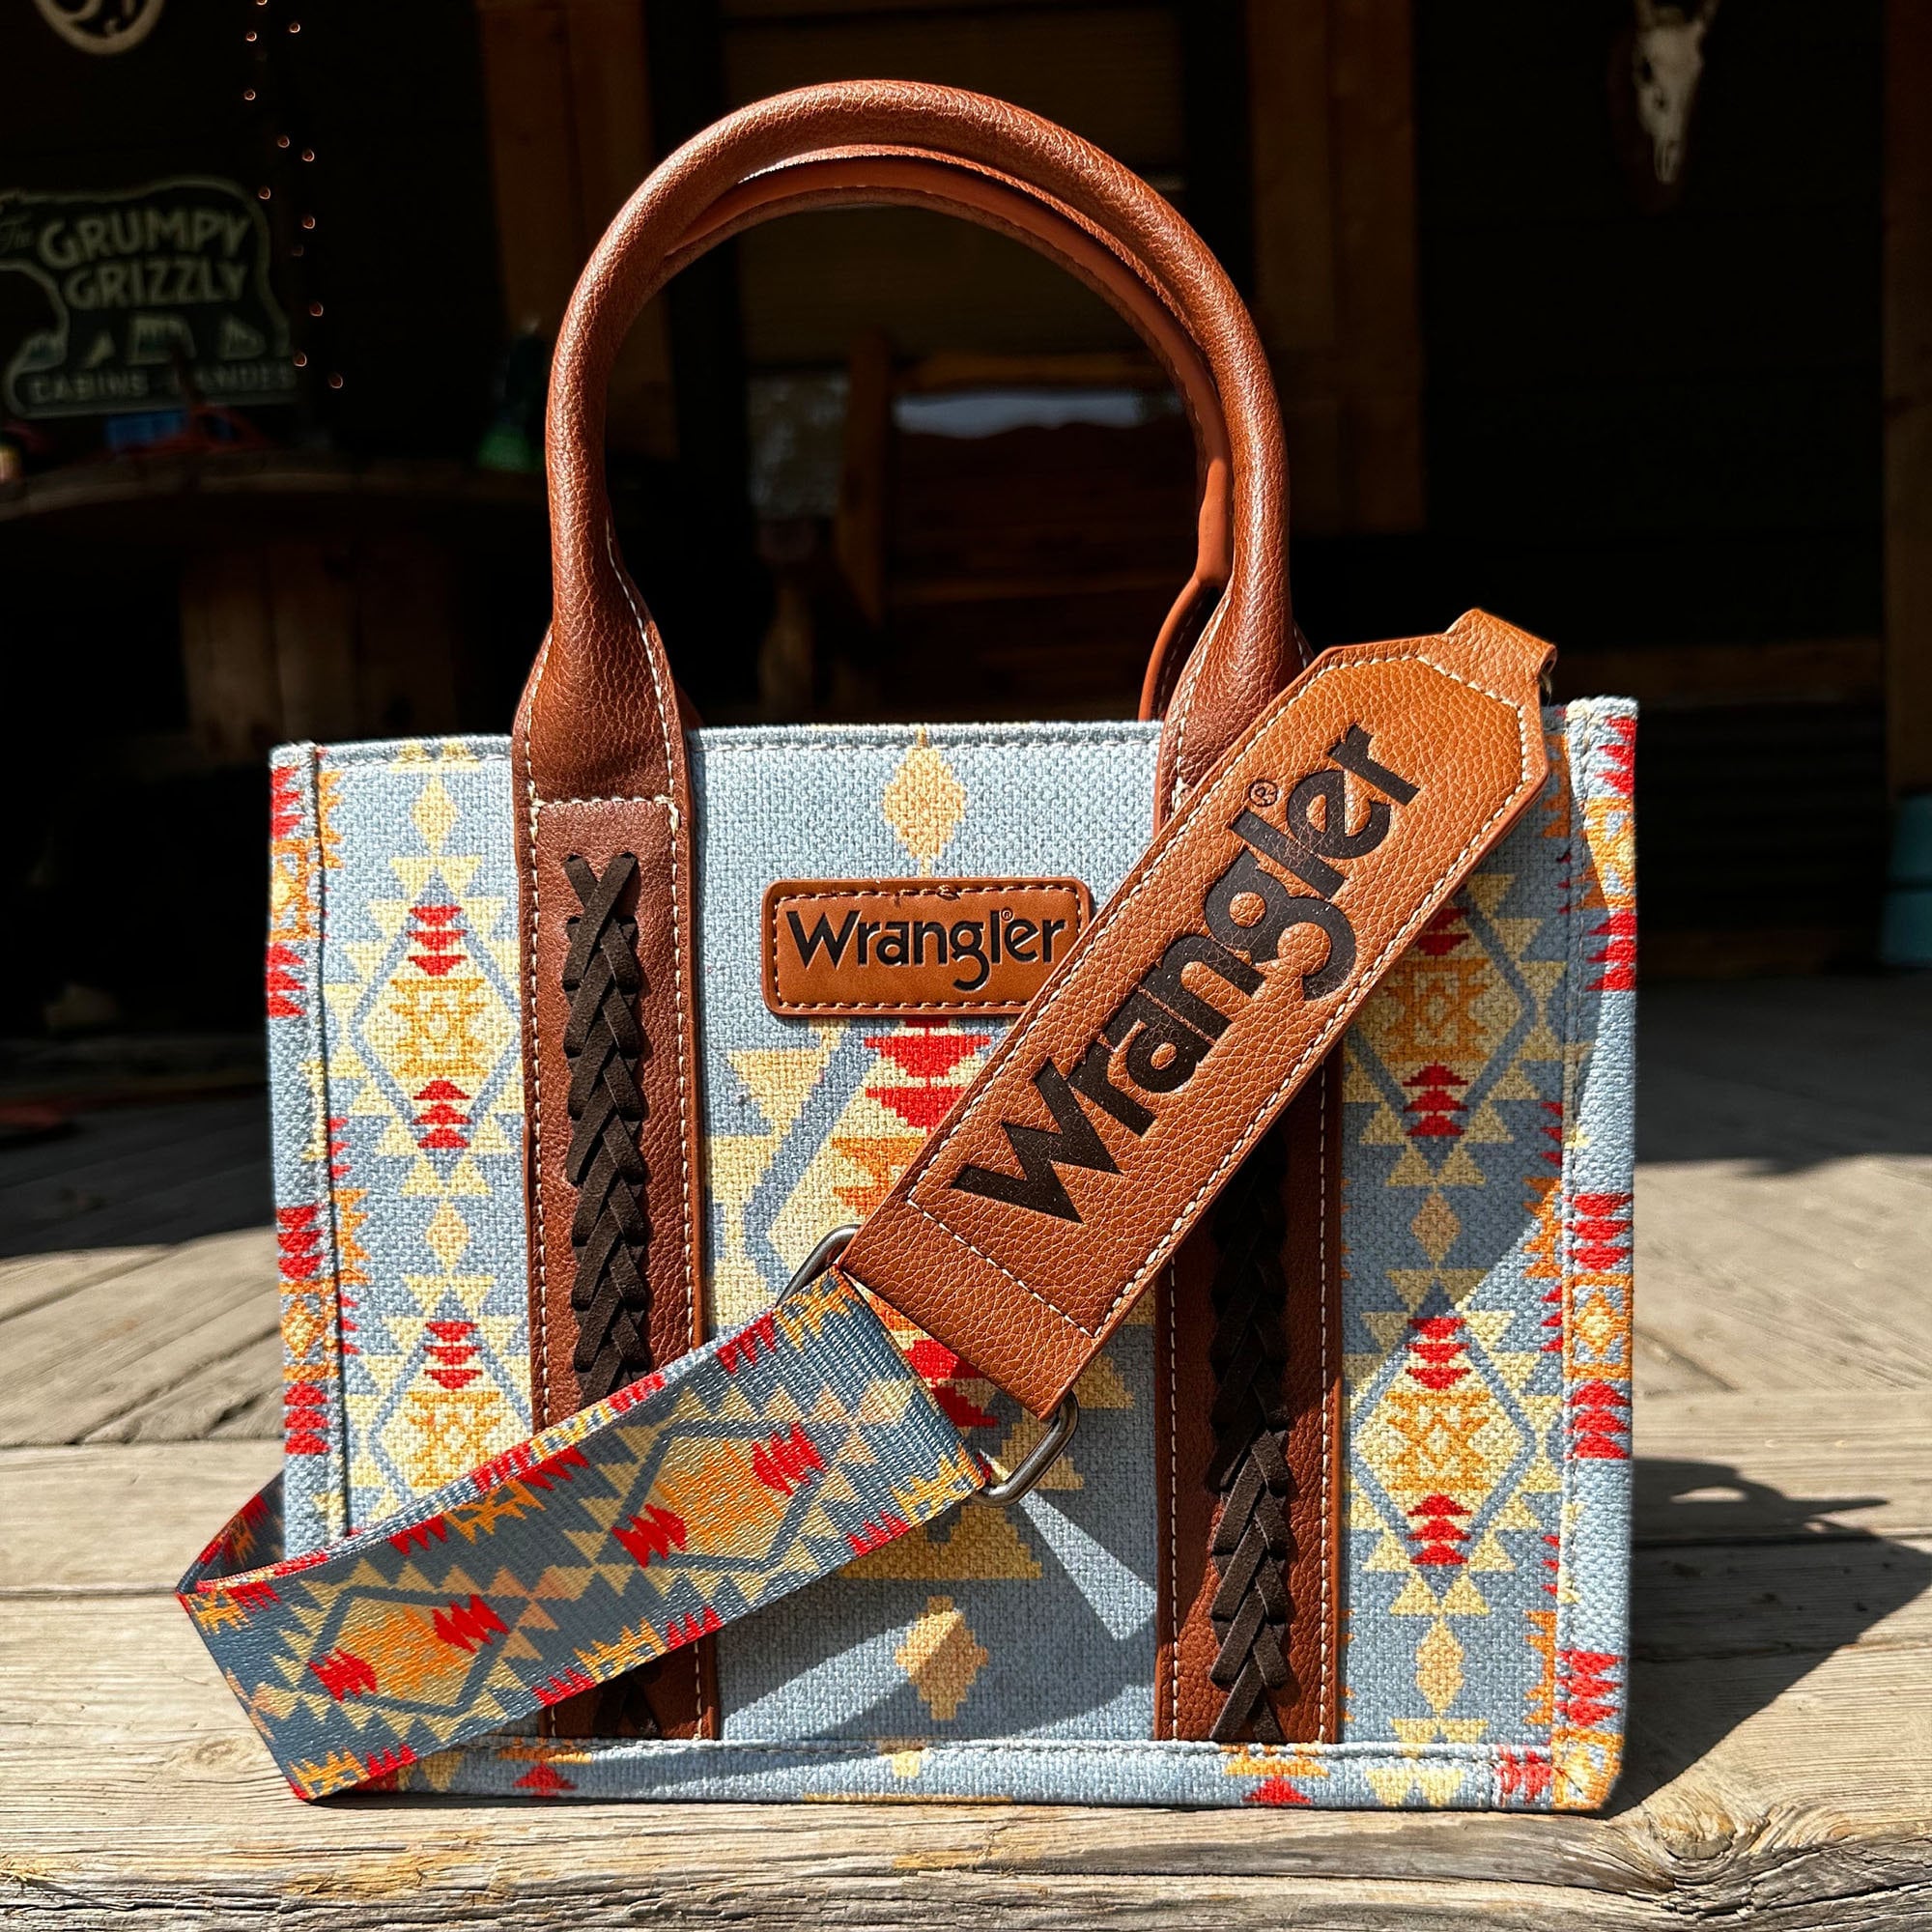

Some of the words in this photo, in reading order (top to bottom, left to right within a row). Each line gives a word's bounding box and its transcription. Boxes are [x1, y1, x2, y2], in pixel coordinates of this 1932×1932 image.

[37, 207, 251, 270] GRUMPY
[62, 255, 248, 310] GRIZZLY
[785, 908, 1066, 992] Wrangler
[951, 724, 1421, 1225] Wrangler
